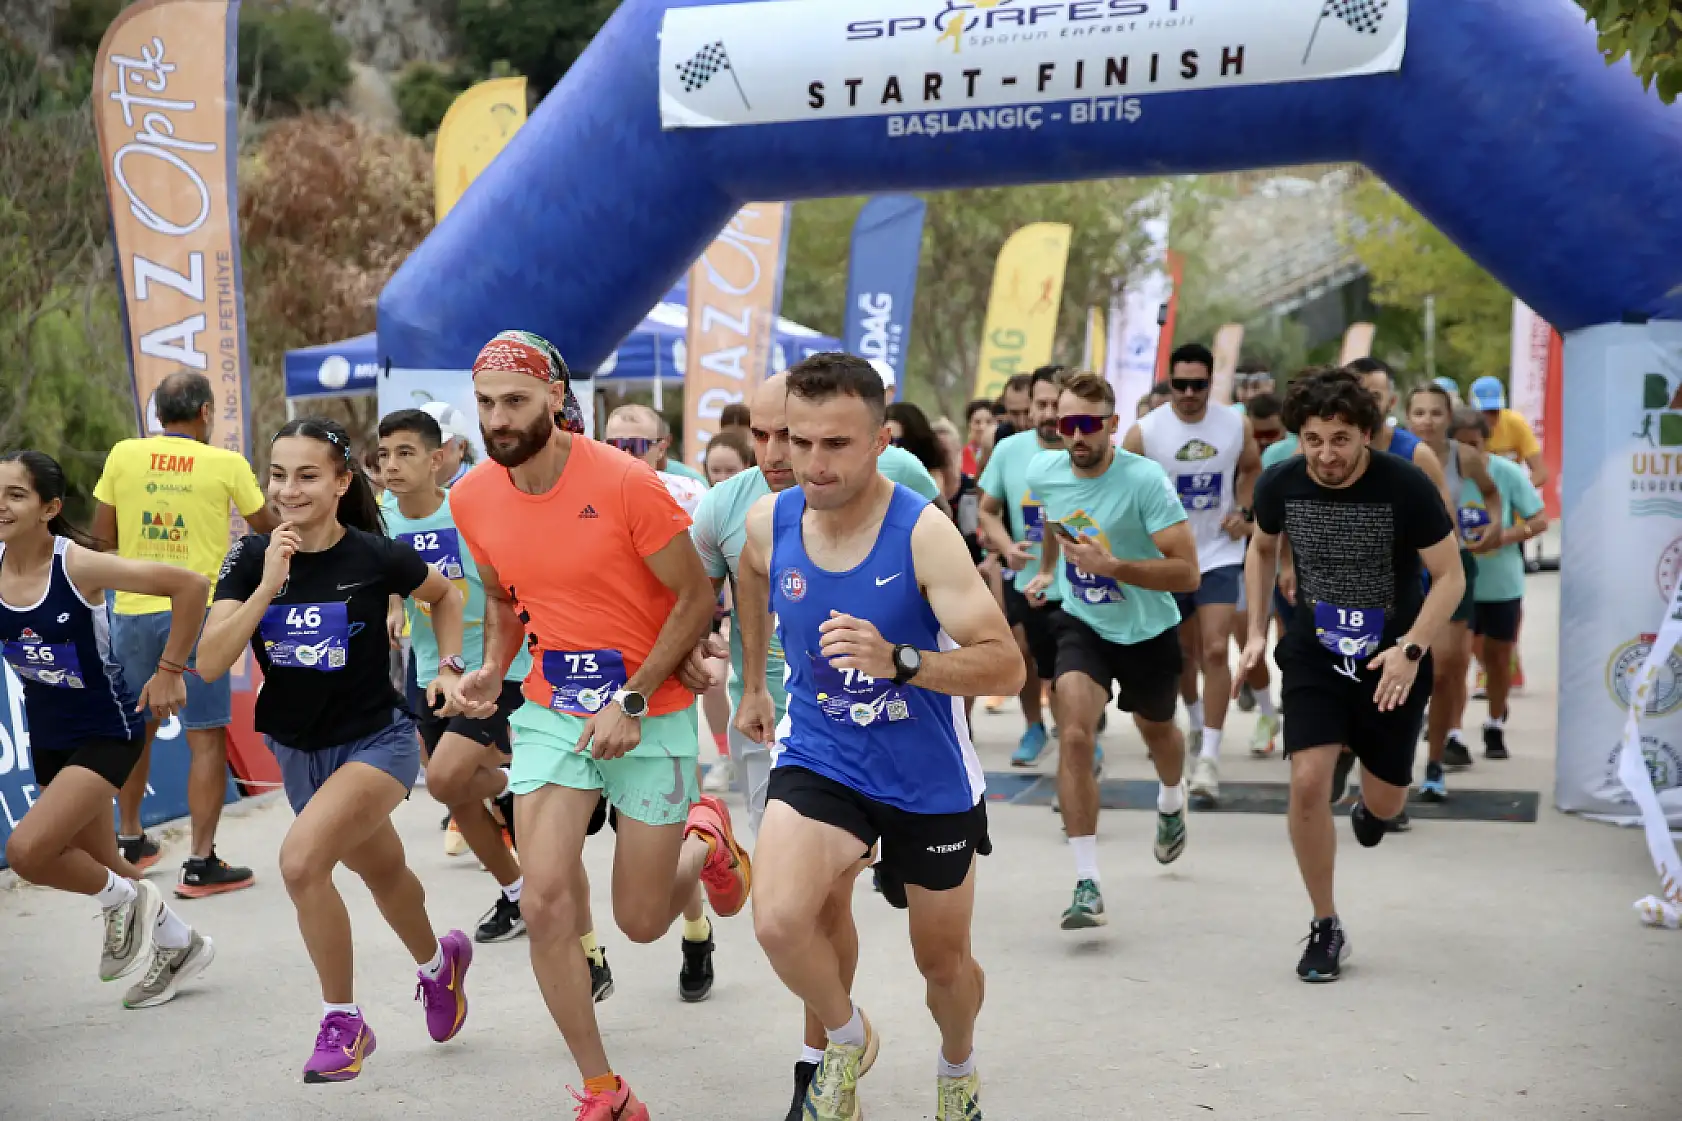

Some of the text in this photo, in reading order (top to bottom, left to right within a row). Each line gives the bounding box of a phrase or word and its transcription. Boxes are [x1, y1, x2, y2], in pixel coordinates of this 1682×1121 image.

[886, 104, 1044, 138] BAŞLANGIÇ
[1070, 96, 1142, 124] BİTİŞ
[214, 250, 234, 331] FETHİYE
[150, 453, 195, 473] TEAM
[413, 532, 440, 551] 82
[286, 606, 321, 628] 46
[1336, 608, 1364, 627] 18
[22, 645, 55, 662] 36
[564, 653, 599, 673] 73
